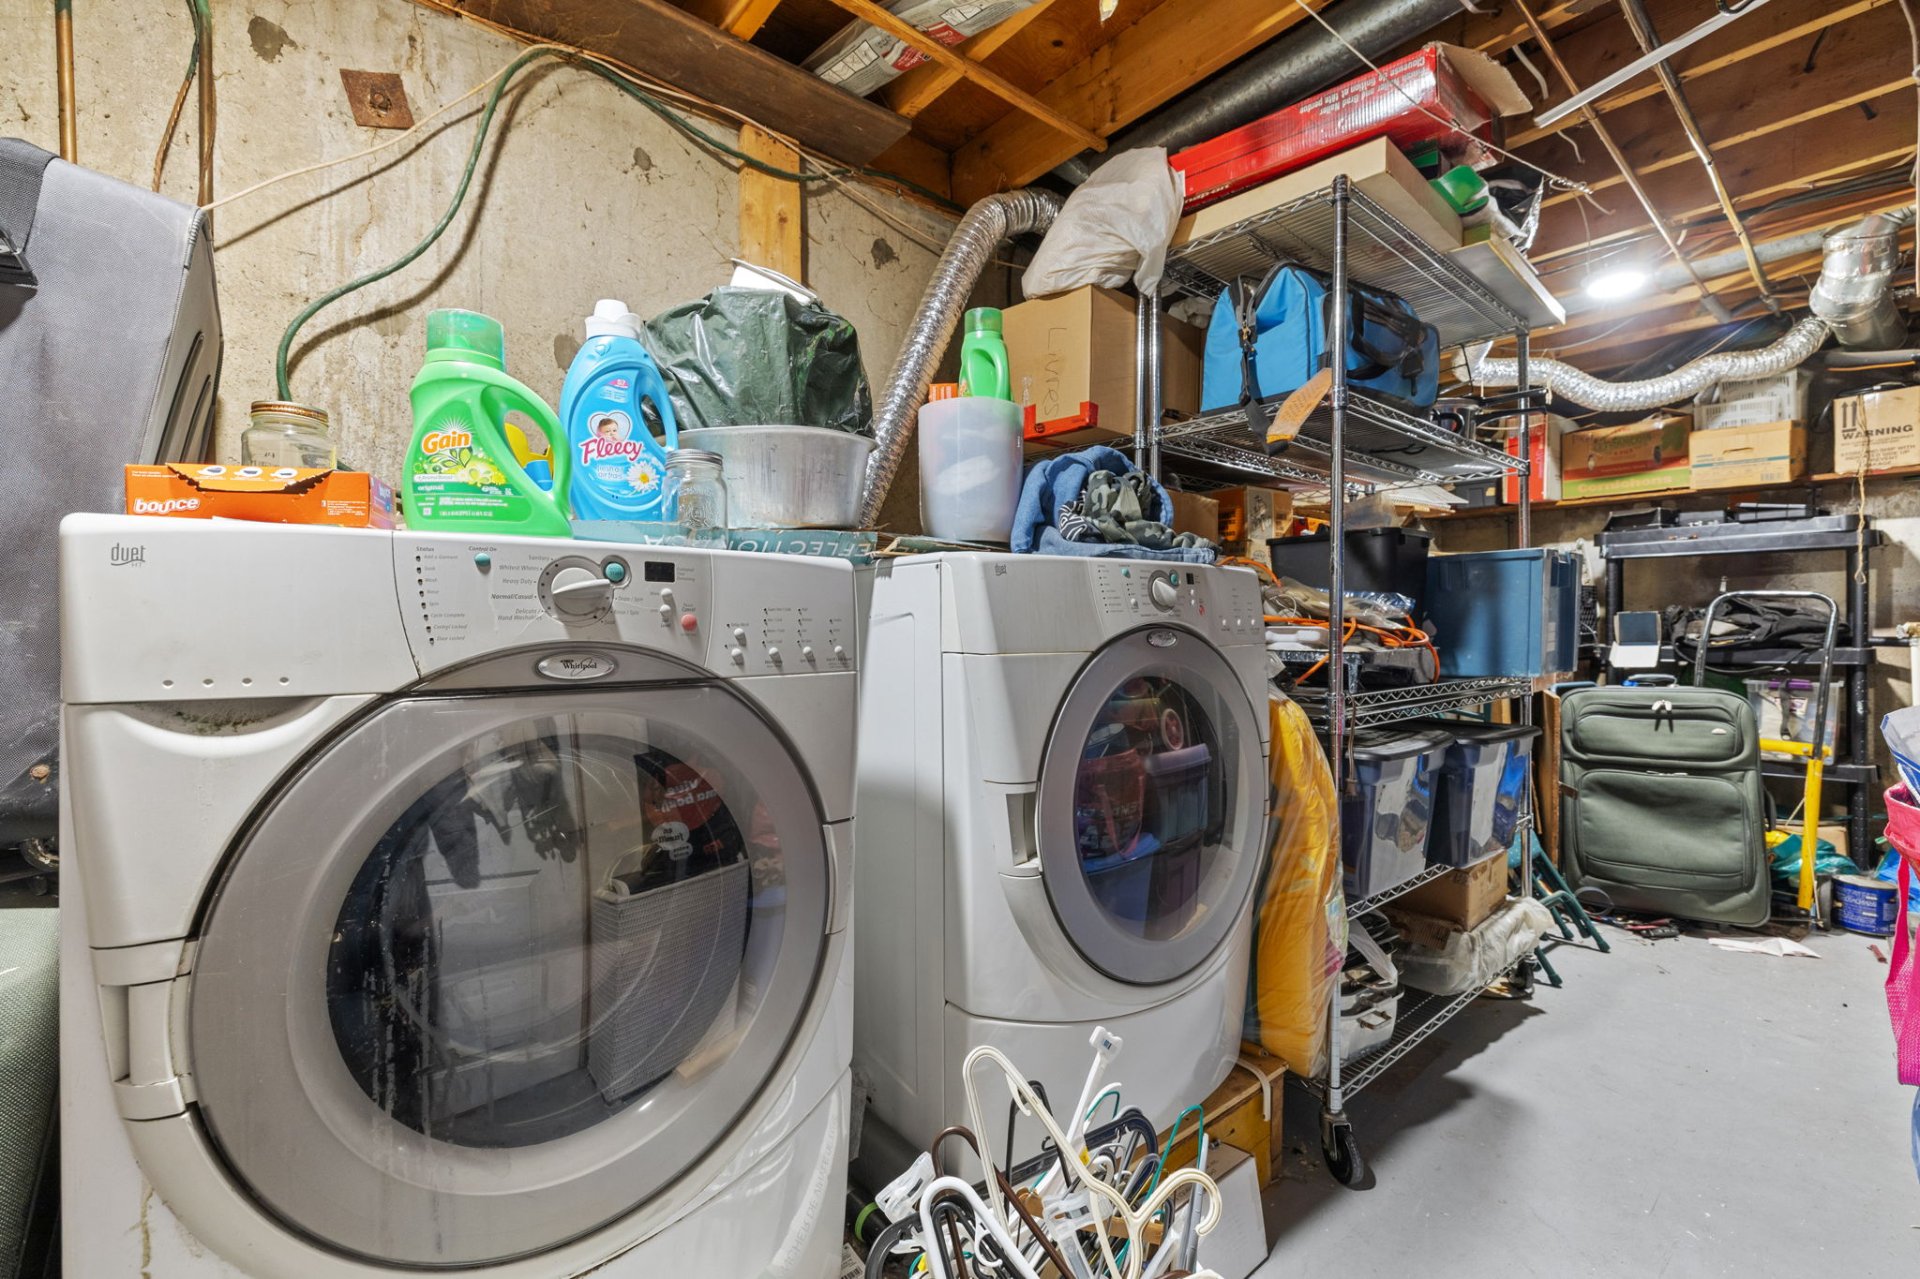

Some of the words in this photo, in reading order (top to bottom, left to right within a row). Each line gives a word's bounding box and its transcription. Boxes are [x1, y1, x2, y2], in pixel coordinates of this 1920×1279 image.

[1318, 100, 1340, 117] Nailer
[1842, 424, 1914, 441] WARNING
[422, 431, 472, 455] Gain
[580, 437, 643, 465] Fleecy
[134, 497, 200, 514] bounce
[111, 542, 146, 565] duet
[562, 660, 598, 672] Whirlpool
